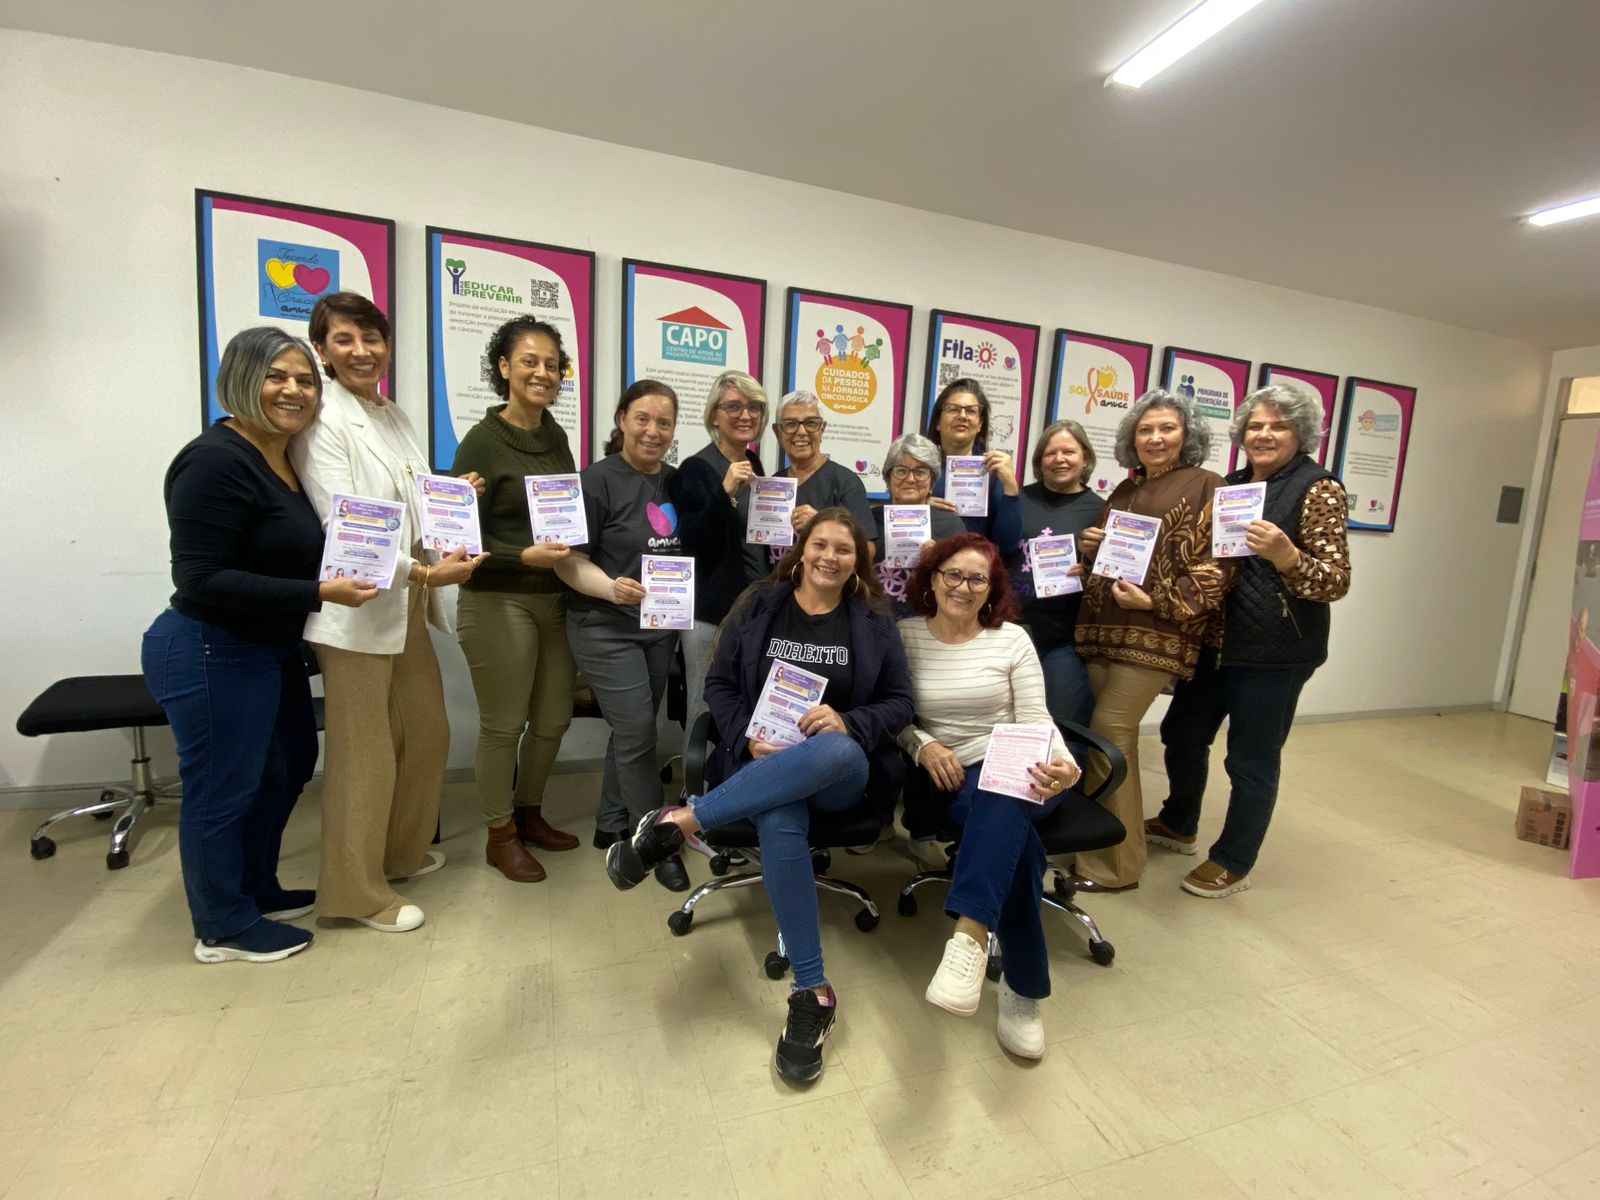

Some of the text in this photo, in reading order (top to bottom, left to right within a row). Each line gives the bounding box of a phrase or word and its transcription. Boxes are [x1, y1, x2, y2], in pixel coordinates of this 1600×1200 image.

[277, 247, 320, 265] Tecendo
[464, 280, 514, 295] EDUCAR
[464, 288, 523, 304] PREVENIR
[280, 305, 312, 314] amuc
[666, 325, 723, 350] CAPO
[942, 338, 974, 361] Fila
[823, 367, 871, 380] CUIDADOS
[822, 376, 870, 389] DA PESSOA
[821, 384, 870, 396] NA JORNADA
[1069, 384, 1130, 401] SOL SAÚDE
[1197, 387, 1222, 398] PROGRAMA
[821, 393, 869, 404] ONCOLÓGICA
[1100, 400, 1129, 409] amucc
[766, 637, 849, 666] DIREITO
